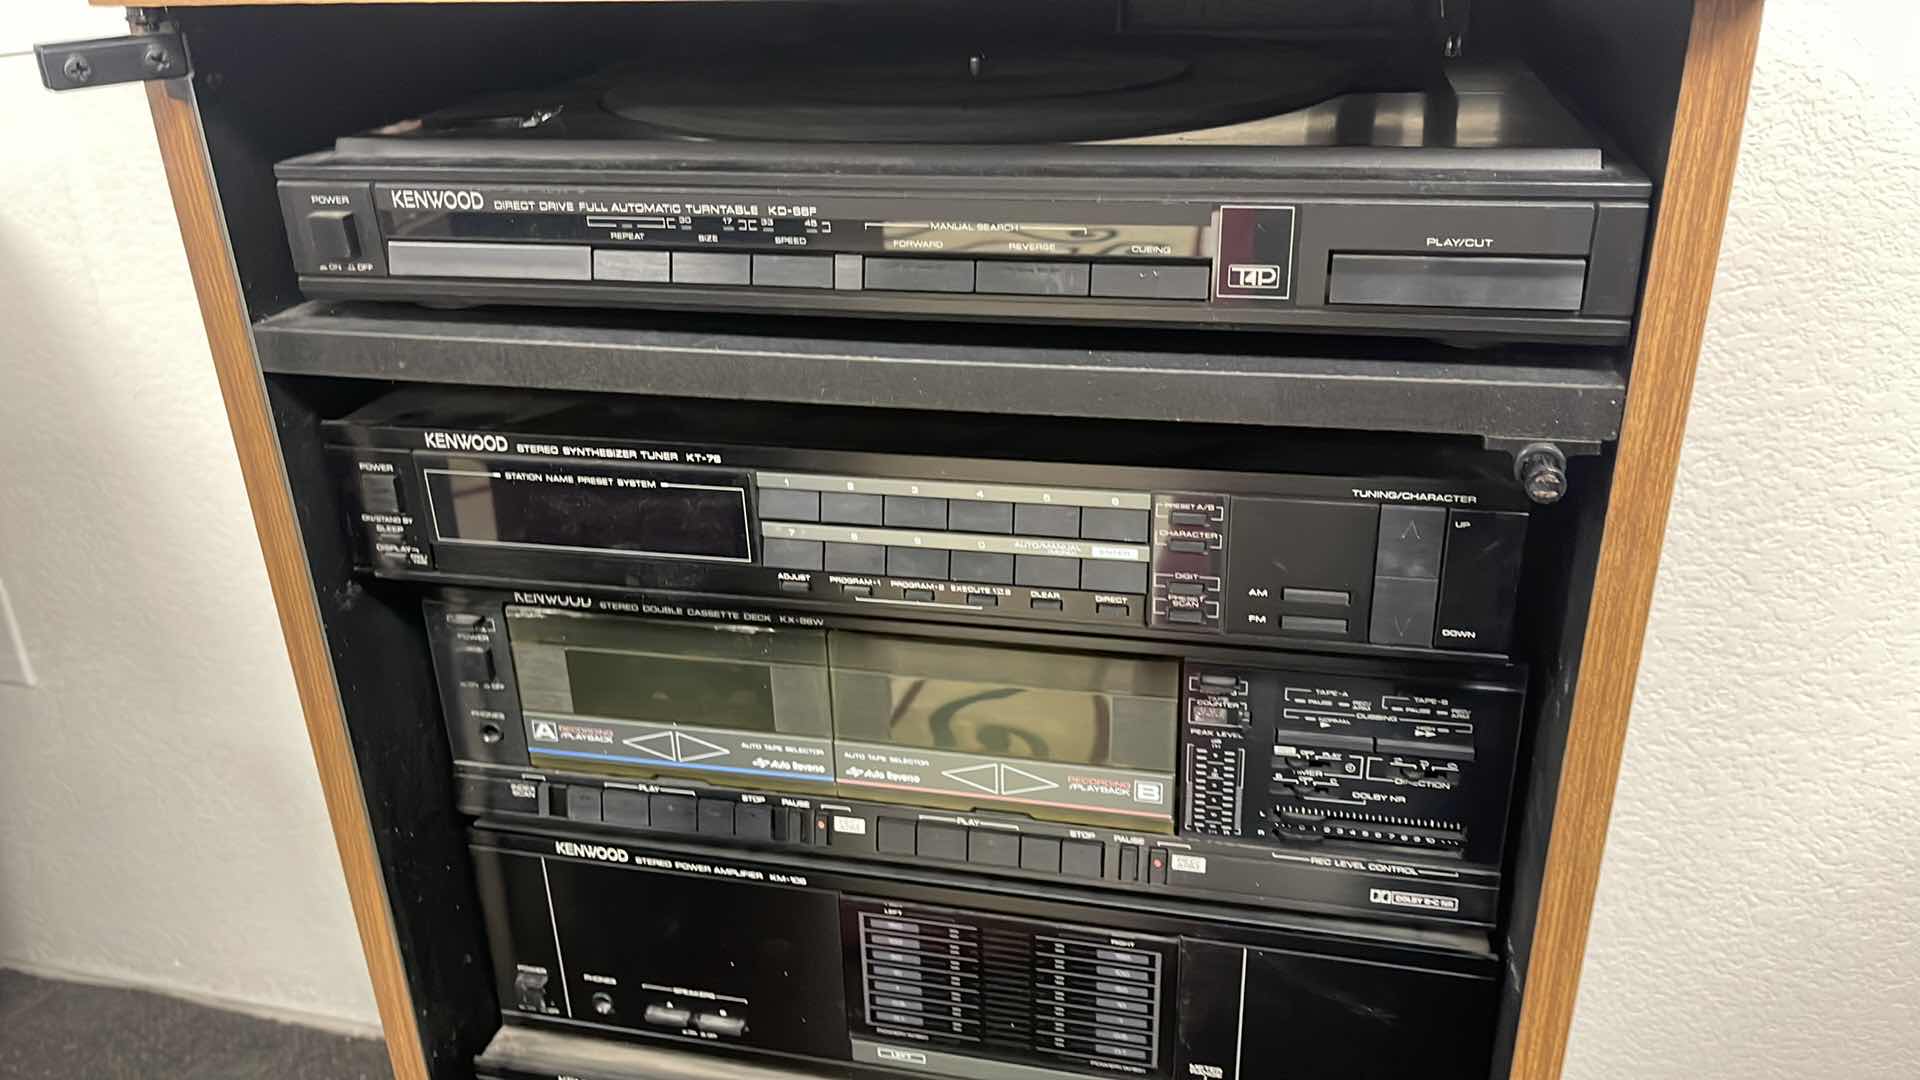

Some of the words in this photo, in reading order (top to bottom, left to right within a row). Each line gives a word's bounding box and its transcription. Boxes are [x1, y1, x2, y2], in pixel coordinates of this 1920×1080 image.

[311, 195, 350, 205] POWER
[391, 190, 484, 210] KENWOOD
[494, 201, 535, 211] DIRECT
[539, 201, 575, 212] DRIVE
[579, 202, 608, 213] FULL
[611, 203, 681, 214] AUTOMATIC
[685, 204, 758, 216] TURNTABLE
[931, 221, 973, 231] MANUAL
[610, 232, 645, 241] REPEAT
[698, 234, 719, 243] SIZE
[775, 236, 807, 246] SPEED
[893, 240, 943, 249] FORWARD
[1008, 242, 1056, 252] REVERSE
[1426, 237, 1494, 249] PLAY/CUT
[424, 431, 508, 451] KENWOOD
[517, 443, 558, 455] STEREO
[562, 446, 638, 460] SYNTHESIZER
[640, 451, 678, 462] TUNER
[359, 463, 394, 473] POWER
[505, 472, 543, 483] STATION
[546, 474, 574, 484] NAME
[577, 476, 614, 487] PRESET
[617, 478, 656, 489] SYSTEM
[1352, 489, 1477, 504] TUNING/CHARACTER
[1455, 520, 1471, 529] UP
[777, 572, 811, 582] ADJUST
[1248, 588, 1268, 598] AM
[513, 591, 592, 608] KENWOOD
[600, 601, 639, 612] STEREO
[642, 604, 683, 616] DOUBLE
[687, 608, 739, 621] CASSETTE
[1248, 614, 1267, 624] FM
[1441, 629, 1476, 640] DOWN
[534, 721, 557, 742] A
[1137, 784, 1160, 801] B
[555, 840, 629, 863] KENWOOD
[674, 860, 712, 874] POWER
[1309, 855, 1332, 867] REC
[1334, 858, 1366, 871] LEVEL
[1368, 862, 1418, 877] CONTROL
